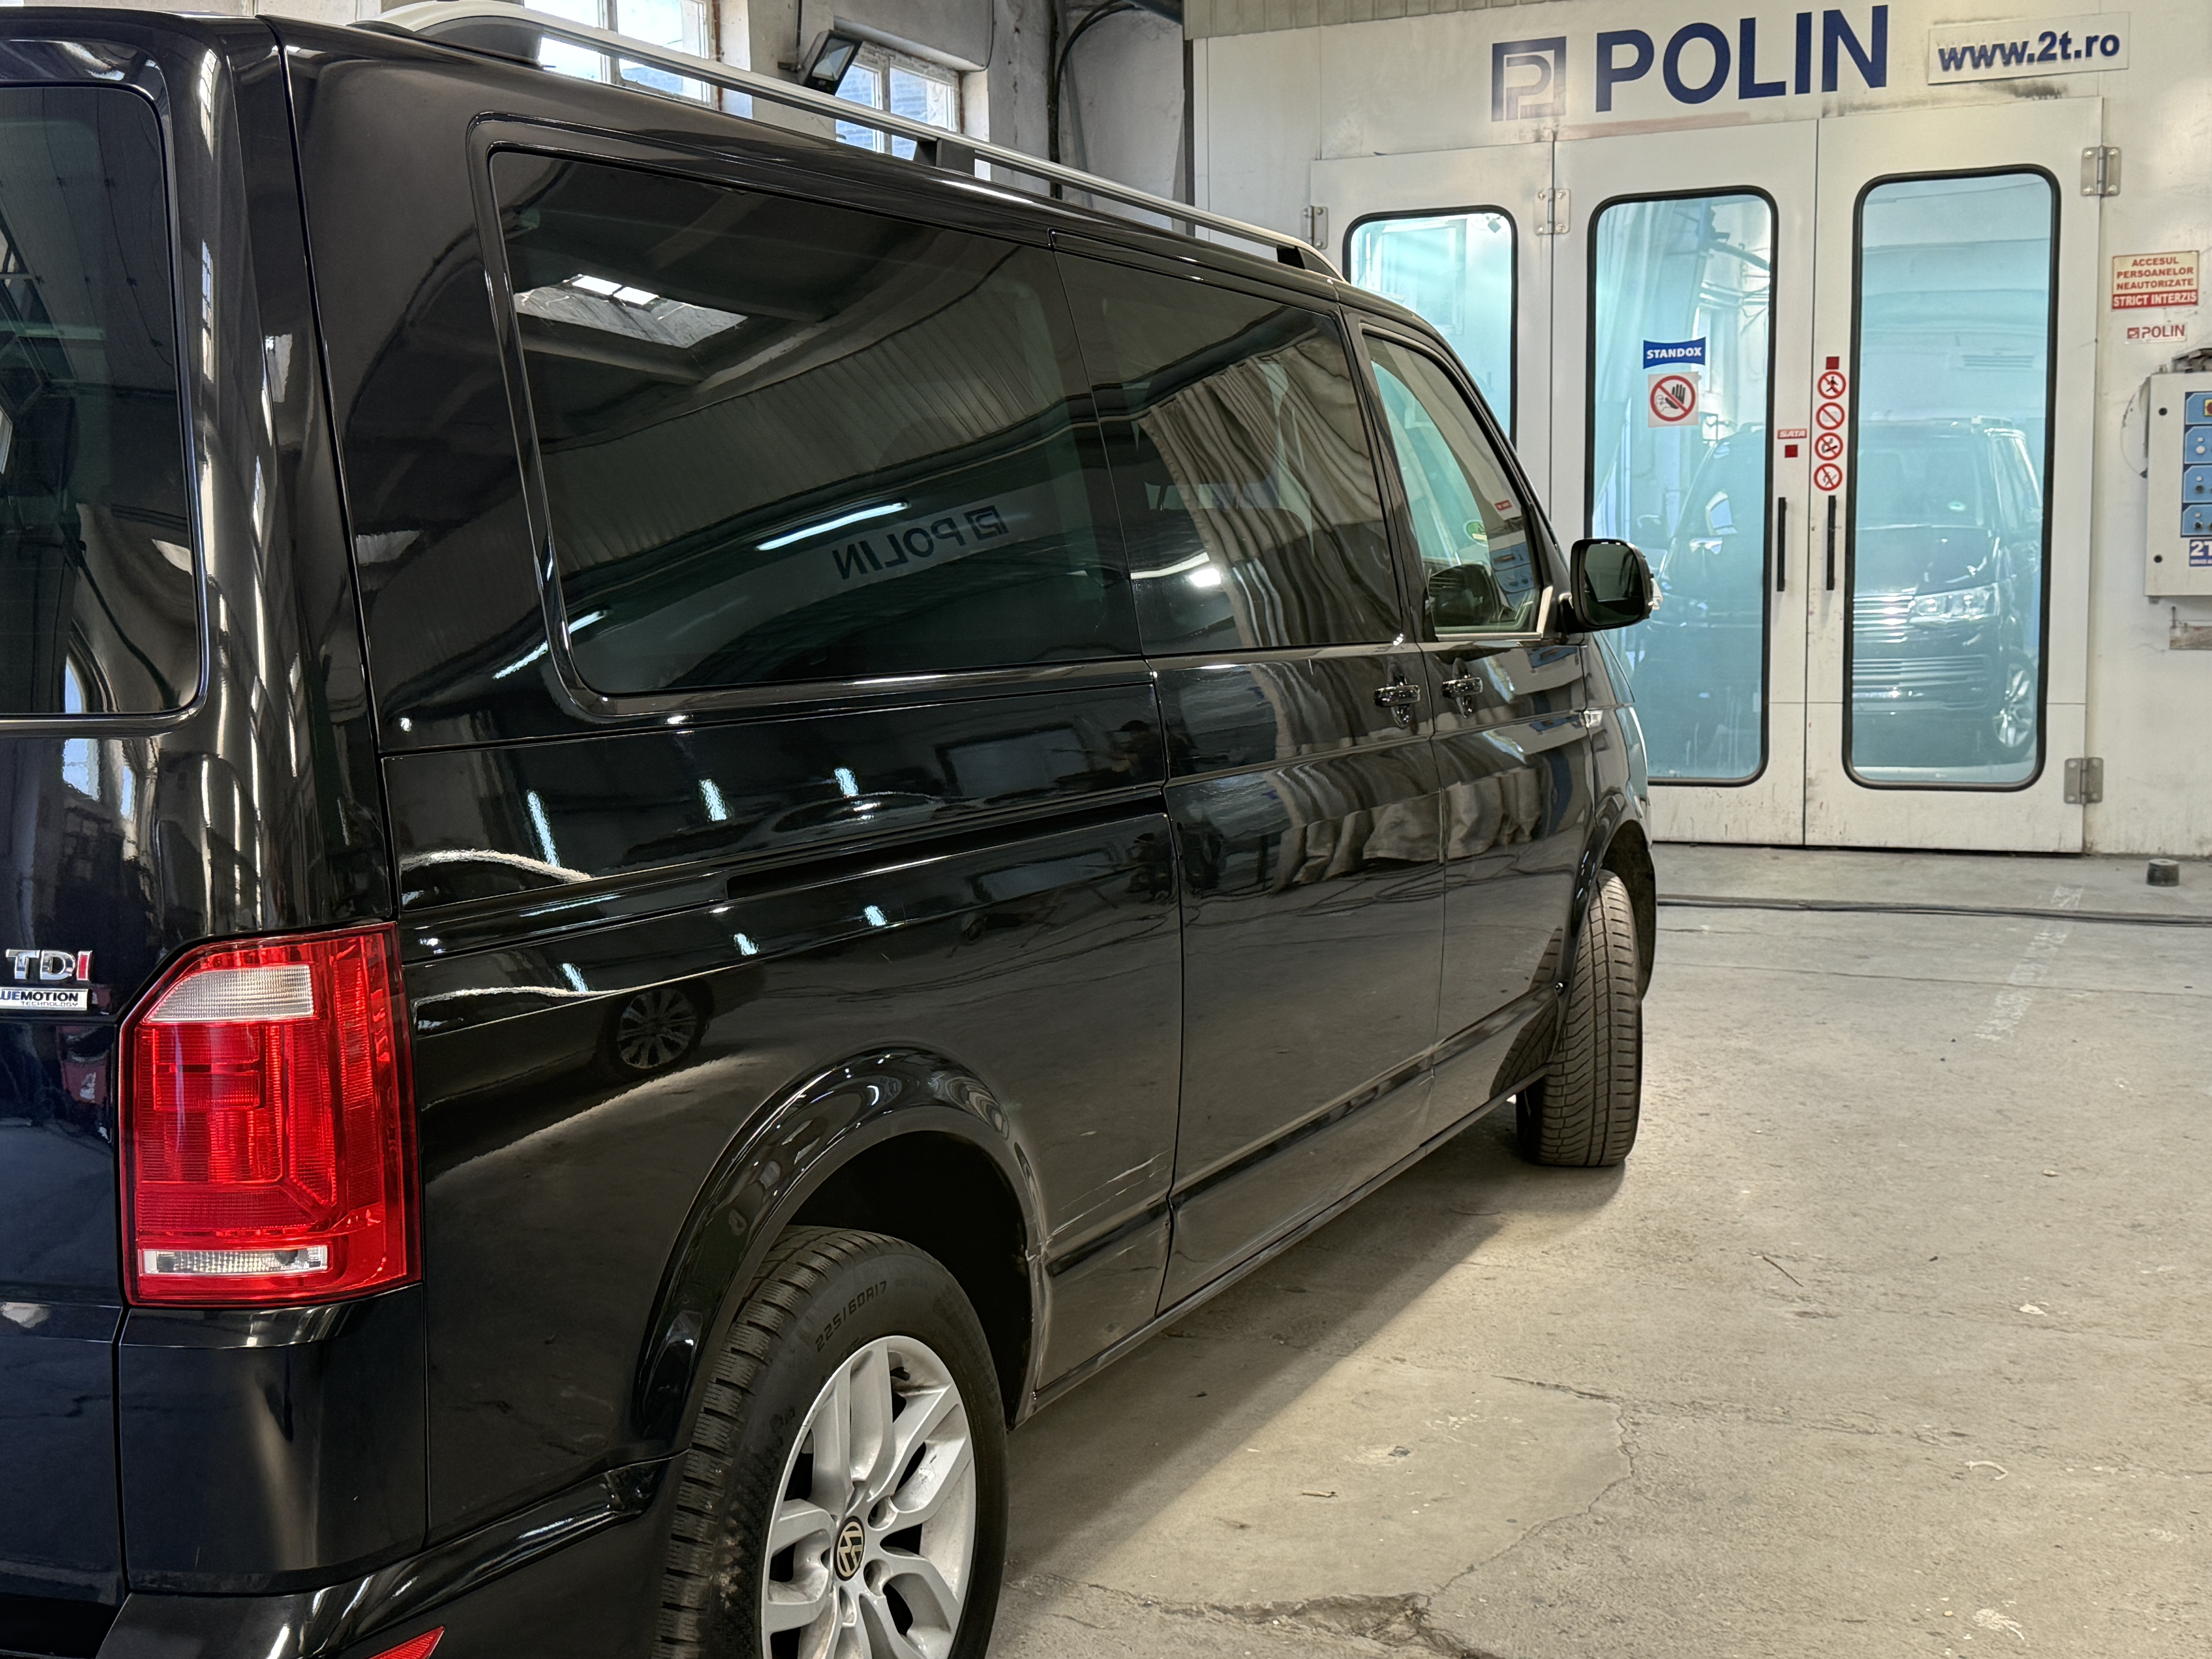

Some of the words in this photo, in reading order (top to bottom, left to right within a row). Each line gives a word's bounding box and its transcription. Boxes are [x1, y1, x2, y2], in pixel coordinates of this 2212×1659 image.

[1938, 31, 2120, 72] www.2t.ro
[1595, 5, 1888, 112] POLIN
[2131, 257, 2179, 267] ACCESUL
[2117, 267, 2194, 279] PERSOANELOR
[2116, 278, 2194, 290] NEAUTORIZATE
[2113, 295, 2149, 307] STRICT
[2151, 292, 2197, 304] INTERZIS
[2142, 324, 2185, 338] POLIN
[1647, 347, 1702, 359] STANDOX
[6, 949, 93, 981] TDI
[0, 991, 78, 1002] UEMOTION
